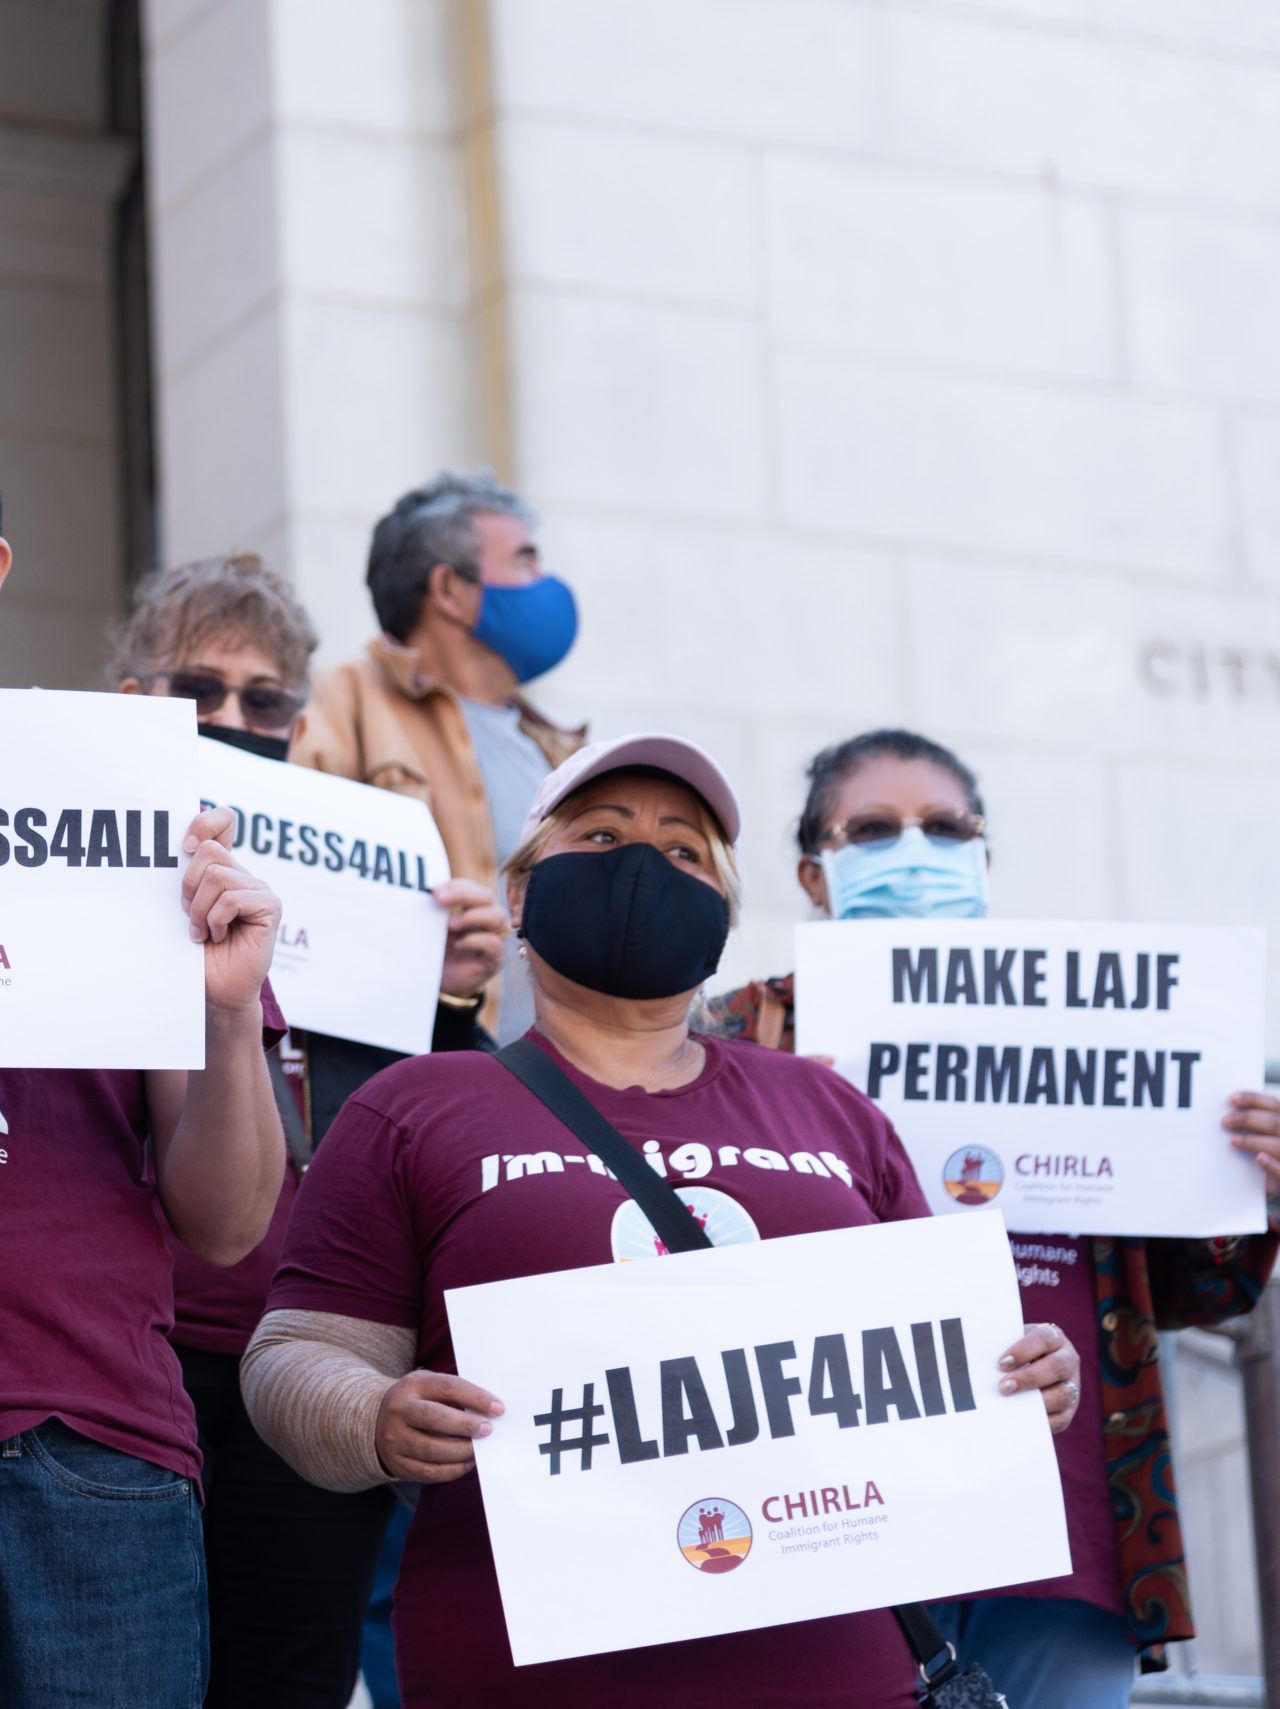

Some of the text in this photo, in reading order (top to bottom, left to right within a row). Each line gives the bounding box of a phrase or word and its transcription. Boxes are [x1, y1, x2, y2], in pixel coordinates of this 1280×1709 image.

[200, 797, 434, 895] OCESS4ALL
[891, 948, 1180, 1011] MAKE LAJF
[866, 1042, 1201, 1110] PERMANENT
[1014, 1153, 1114, 1177] CHIRLA
[1016, 1261, 1060, 1287] ights
[762, 1480, 885, 1523] CHIRLA
[768, 1514, 888, 1541] Coalition for Humane
[781, 1531, 878, 1554] Immigrant Rights
